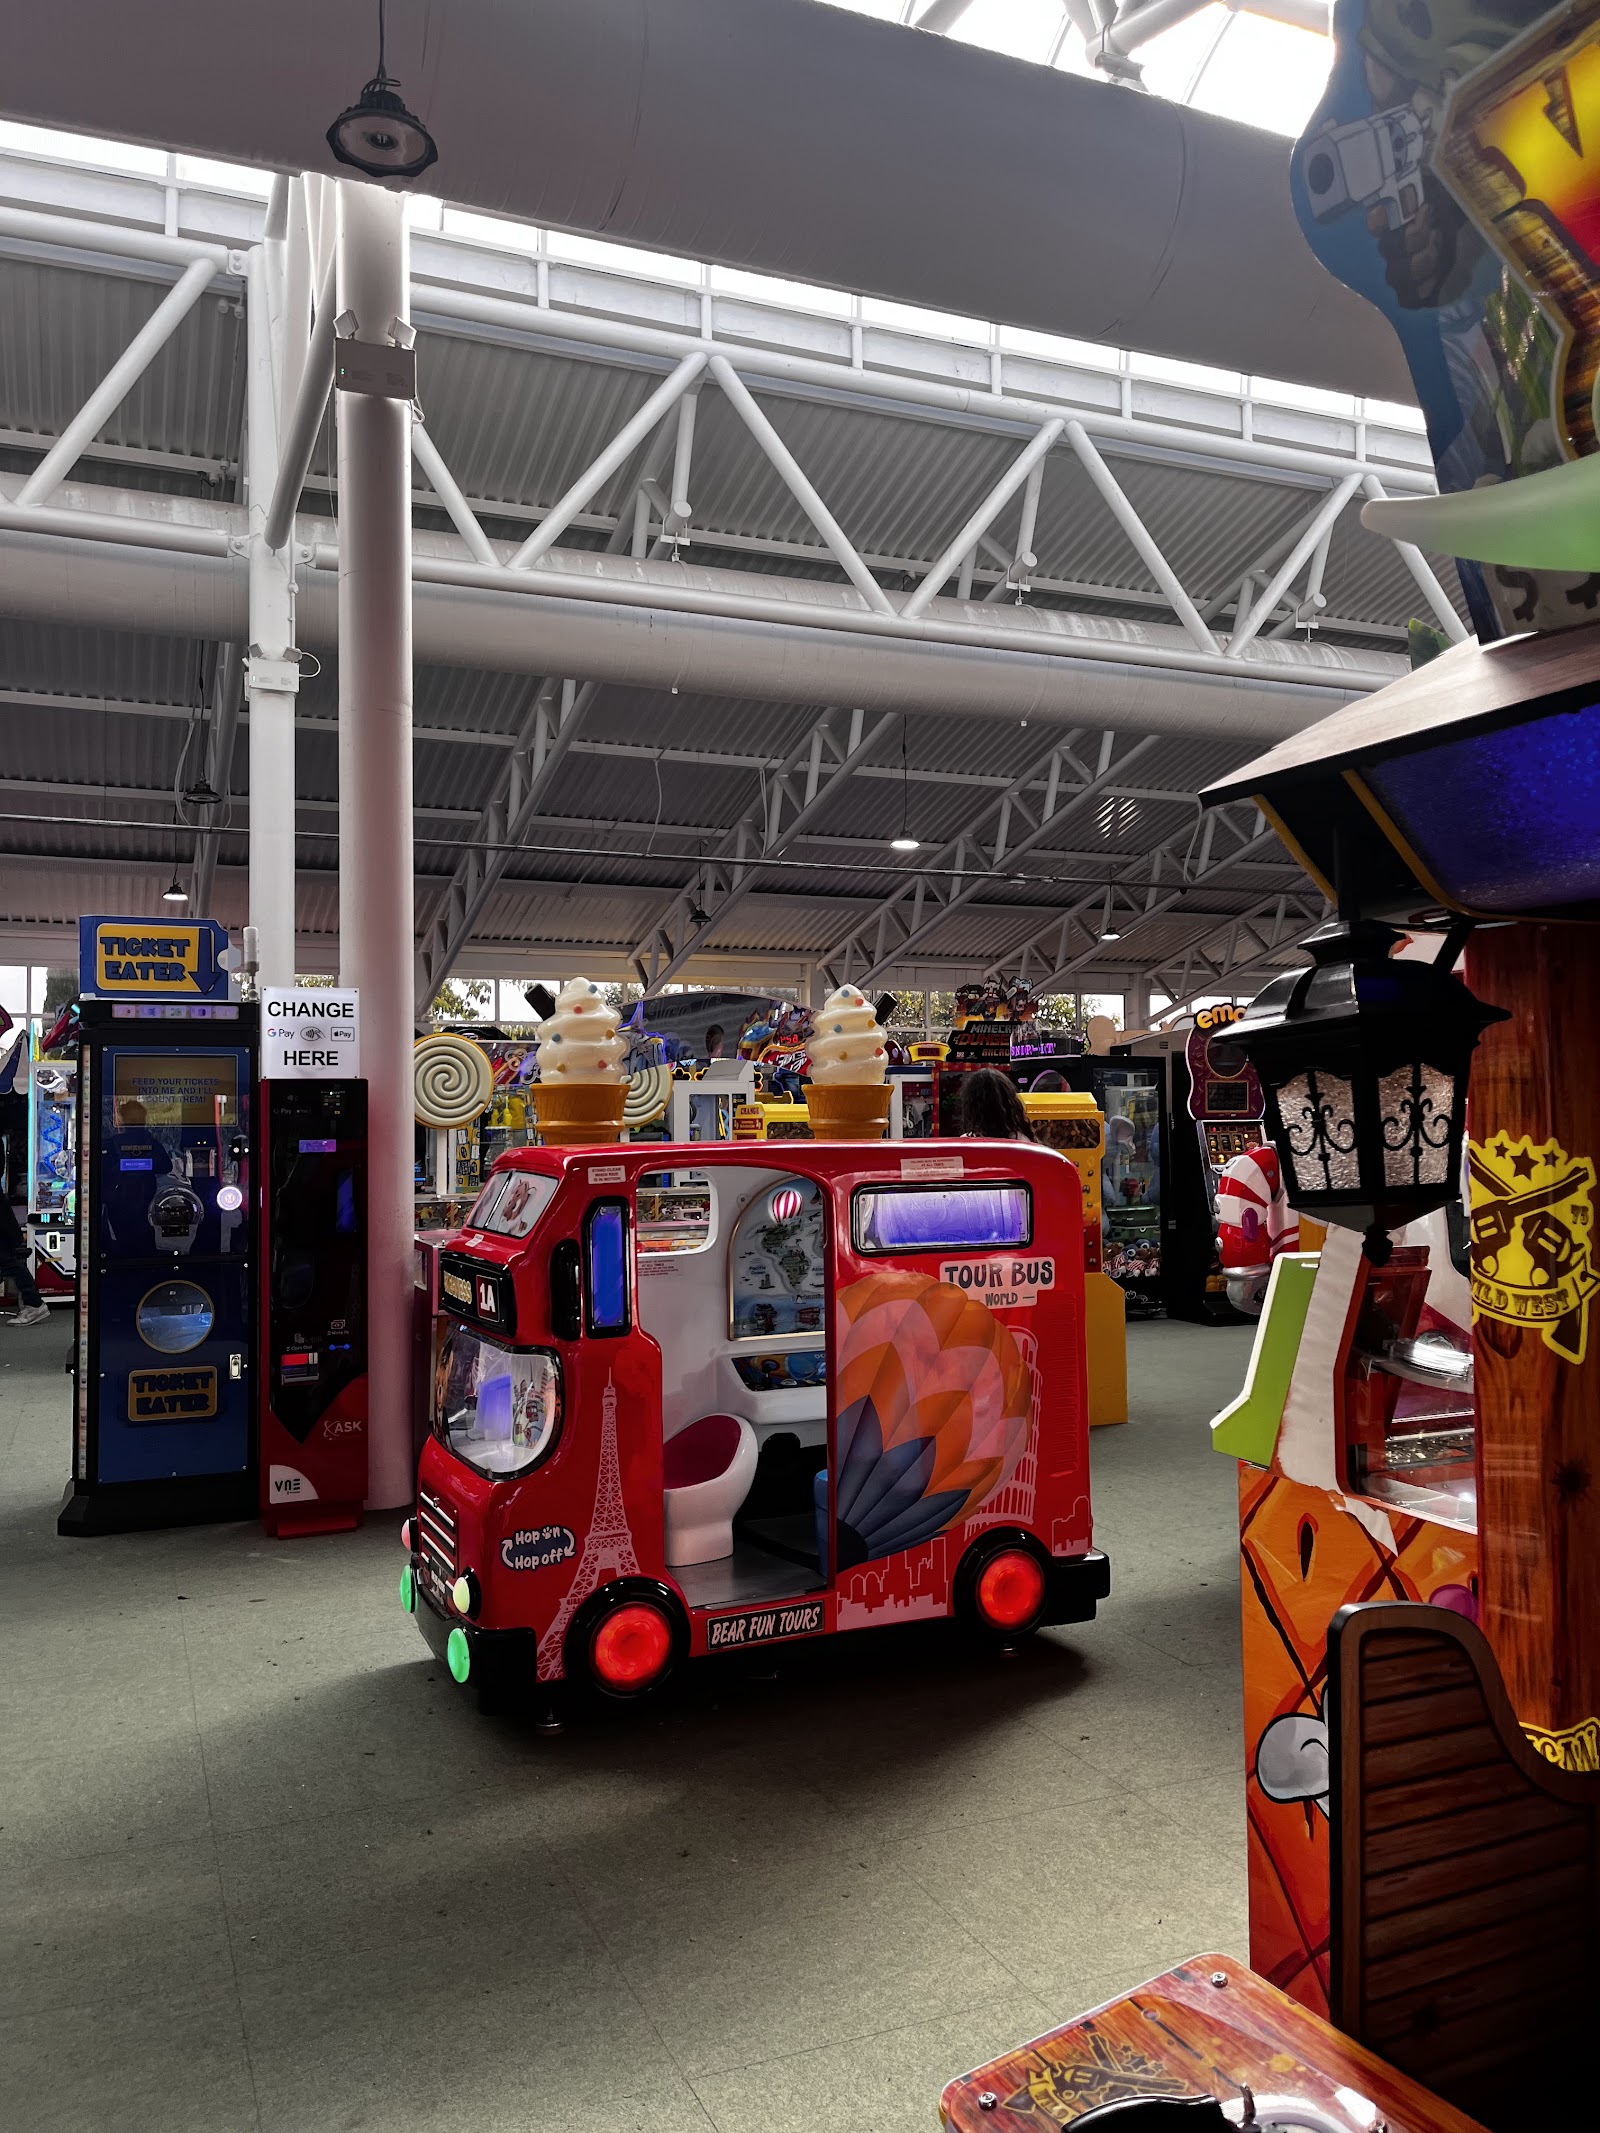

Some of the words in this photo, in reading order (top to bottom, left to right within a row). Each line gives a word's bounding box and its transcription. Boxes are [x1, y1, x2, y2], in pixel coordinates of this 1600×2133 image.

[100, 937, 190, 957] TICKET
[104, 961, 187, 982] EATER
[268, 1001, 354, 1018] CHANGE
[279, 1028, 295, 1040] Pay
[284, 1050, 339, 1066] HERE
[982, 1049, 1010, 1057] ARCAD
[133, 1078, 155, 1086] FEED
[158, 1078, 181, 1086] YOUR
[184, 1078, 219, 1086] TICKETS
[139, 1087, 158, 1095] INTO
[162, 1087, 175, 1095] ME
[178, 1087, 196, 1095] AND
[199, 1087, 213, 1095] I'LL
[145, 1096, 176, 1104] COUNT
[945, 1264, 1003, 1289] TOUR
[1012, 1261, 1053, 1286] BUS
[480, 1282, 496, 1313] 1A
[1511, 1288, 1570, 1318] WEST
[131, 1371, 213, 1393] TICKET
[334, 1421, 363, 1433] ASK
[515, 1530, 540, 1545] Hop
[515, 1555, 540, 1570] Hop
[541, 1548, 564, 1564] off
[711, 1619, 746, 1645] BEAR
[748, 1614, 776, 1639] FUN
[779, 1606, 821, 1634] TOURS
